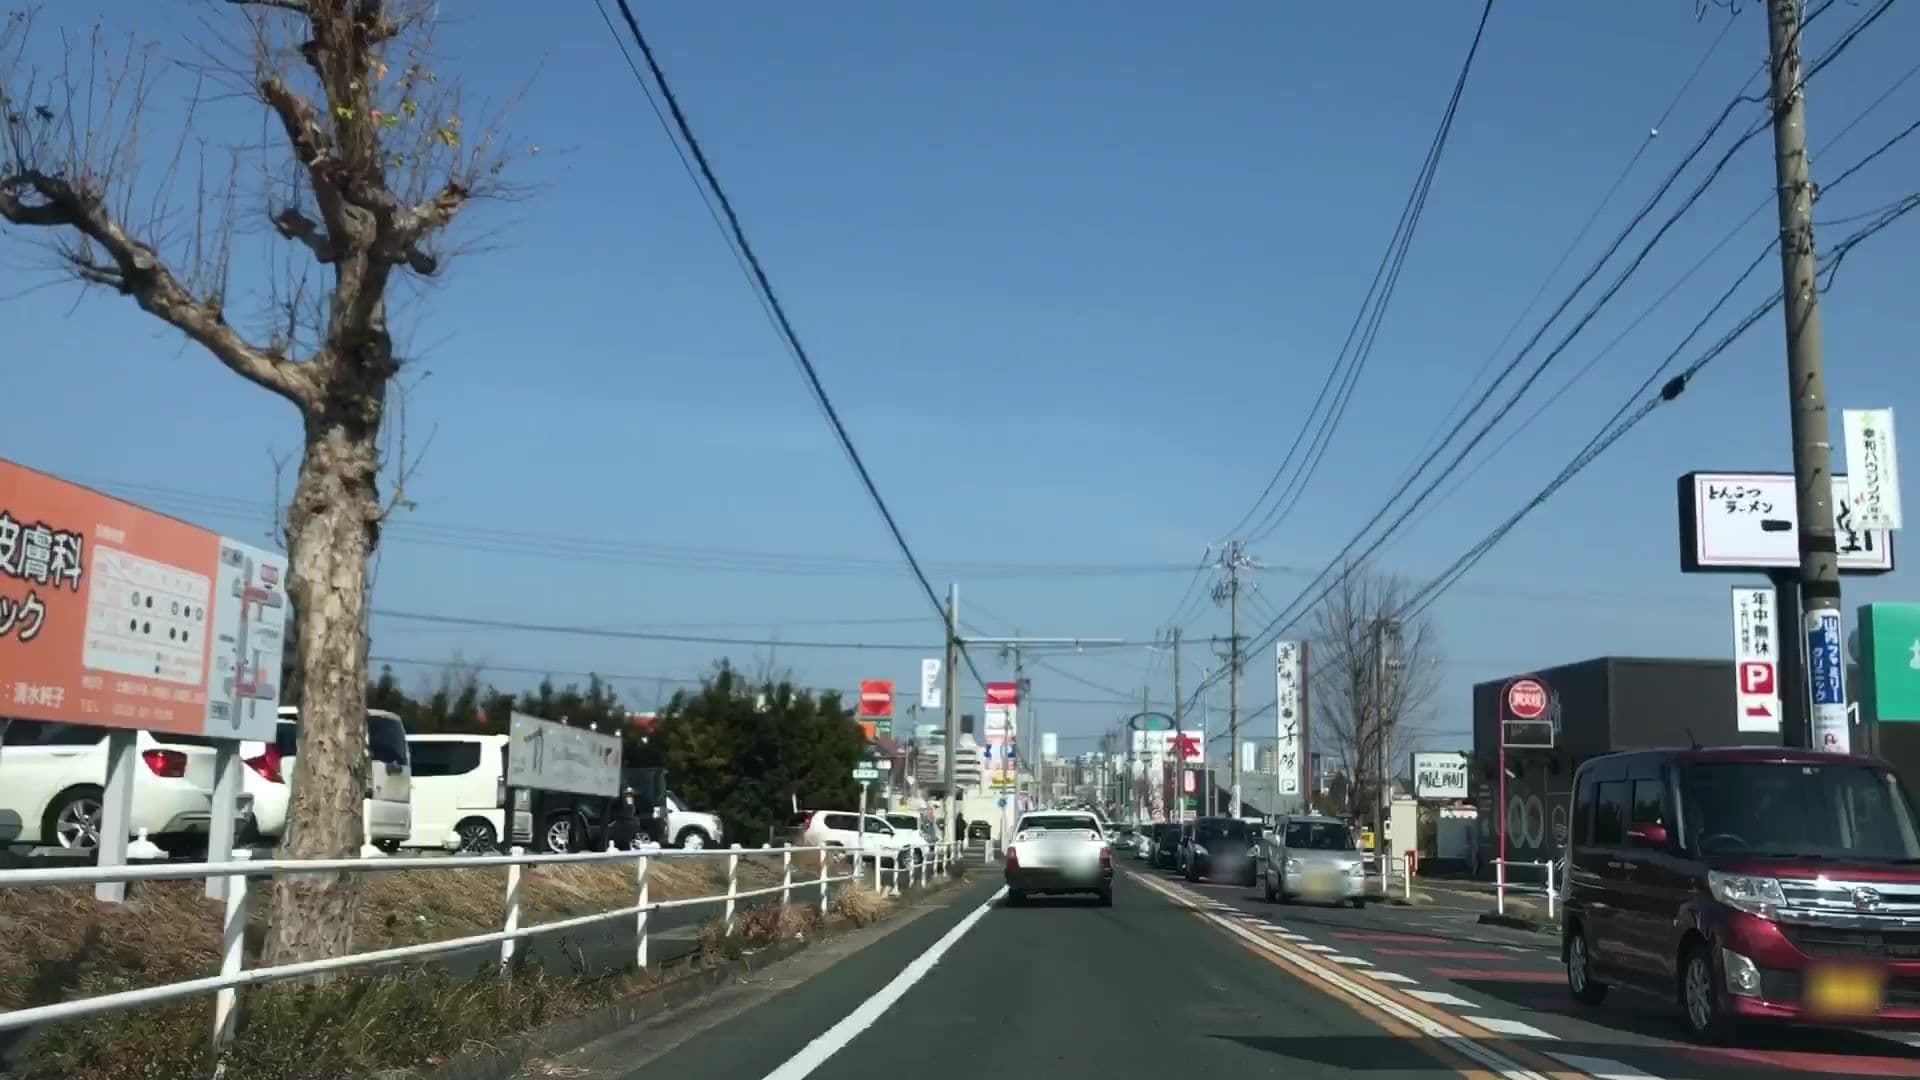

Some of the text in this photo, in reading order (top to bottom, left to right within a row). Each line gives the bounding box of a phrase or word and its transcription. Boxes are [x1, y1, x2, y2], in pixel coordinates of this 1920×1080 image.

[1708, 484, 1762, 500] とんこつ
[1725, 500, 1773, 513] ラーメン
[0, 512, 83, 592] 皮膚科
[1751, 591, 1769, 656] 年中無休
[1747, 665, 1769, 691] P
